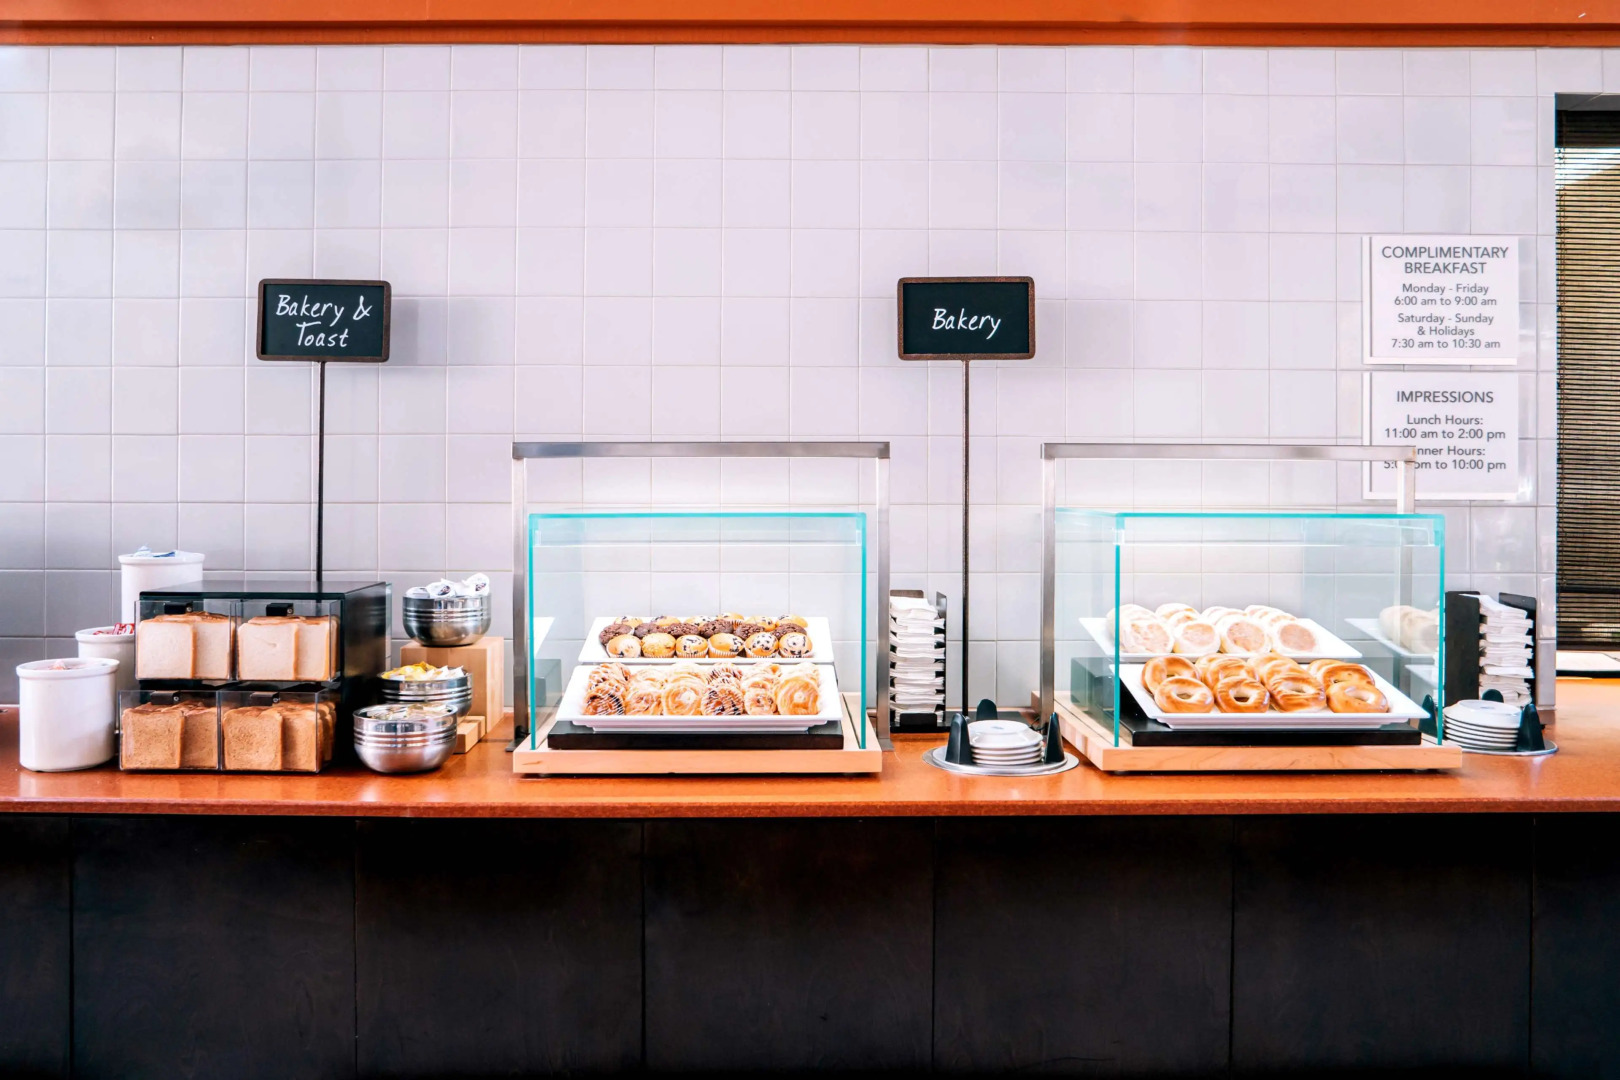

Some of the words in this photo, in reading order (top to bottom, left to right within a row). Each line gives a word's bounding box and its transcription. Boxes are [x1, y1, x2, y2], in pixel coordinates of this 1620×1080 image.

[1382, 246, 1510, 259] COMPLIMENTARY
[1405, 262, 1488, 275] BREAKFAST
[1402, 283, 1446, 296] Monday
[1456, 283, 1490, 296] Friday
[1394, 296, 1418, 306] 6:00
[1440, 298, 1452, 306] to
[1455, 296, 1478, 306] 9:00
[275, 294, 345, 327] Bakery
[352, 295, 373, 321] &
[931, 307, 1001, 340] Bakery
[1398, 313, 1446, 326] Saturday
[1455, 313, 1495, 326] Sunday
[296, 321, 349, 347] Toast
[1417, 326, 1426, 336] &
[1430, 326, 1475, 339] Holidays
[1392, 339, 1415, 349] 7:30
[1418, 341, 1435, 349] am
[1437, 340, 1449, 349] to
[1453, 339, 1482, 349] 10:30
[1397, 391, 1495, 404] IMPRESSIONS
[1407, 415, 1442, 426] Lunch
[1445, 415, 1484, 426] Hours:
[1385, 428, 1418, 439] 11:00
[1421, 431, 1439, 439] am
[1441, 430, 1455, 440] to
[1458, 428, 1484, 440] 2:00
[1487, 432, 1506, 443] pm
[1416, 448, 1445, 456] nner
[1447, 446, 1486, 457] Hours:
[1435, 460, 1448, 470] to
[1452, 459, 1485, 470] 10:00
[1487, 462, 1507, 474] pm
